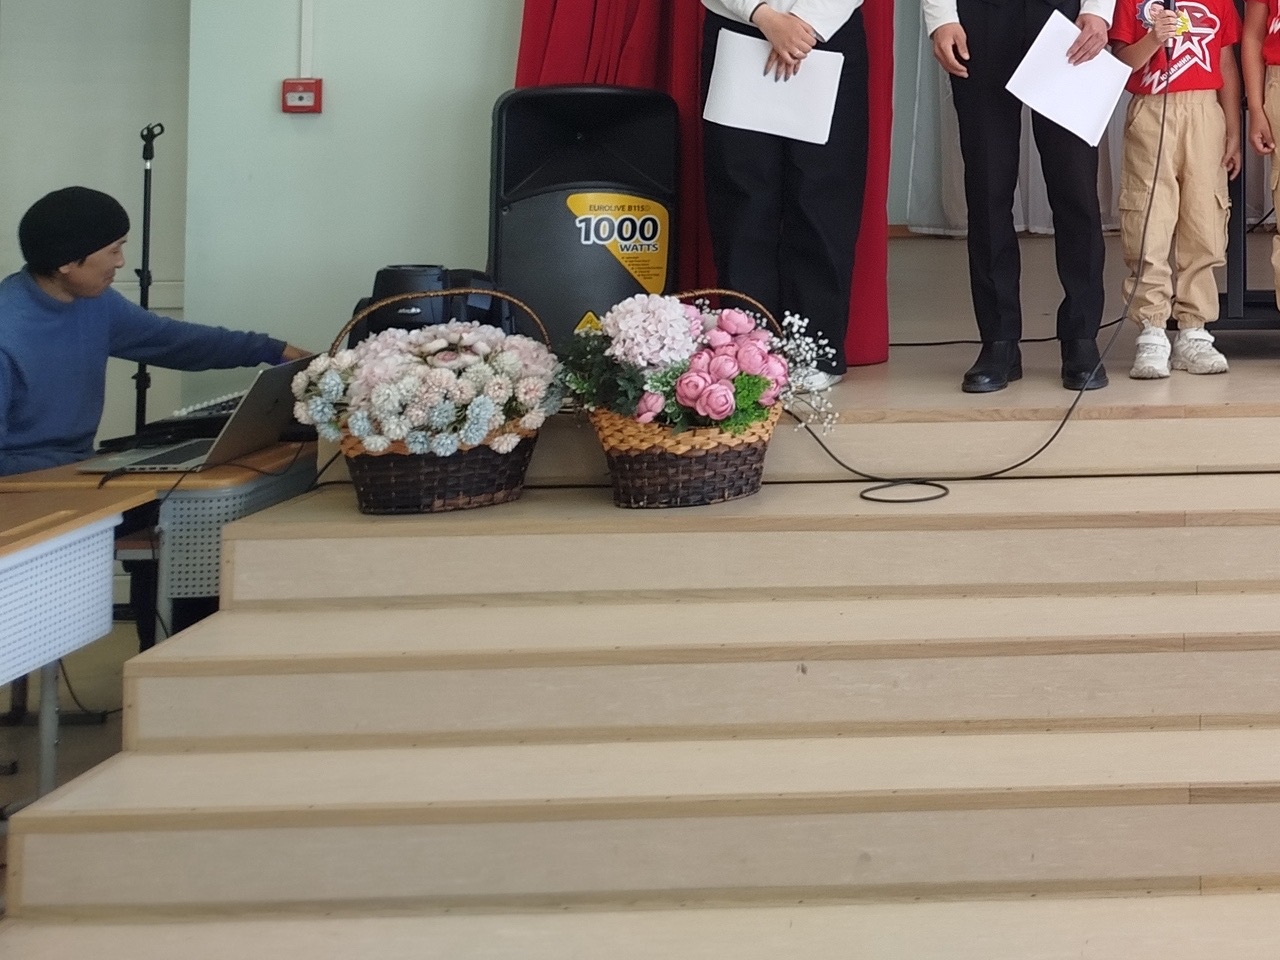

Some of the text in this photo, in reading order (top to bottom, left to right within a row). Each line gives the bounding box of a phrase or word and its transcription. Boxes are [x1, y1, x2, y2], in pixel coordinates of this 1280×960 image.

[589, 204, 625, 212] EUROLIVE
[576, 215, 660, 243] 1000
[619, 243, 659, 253] WATTS
